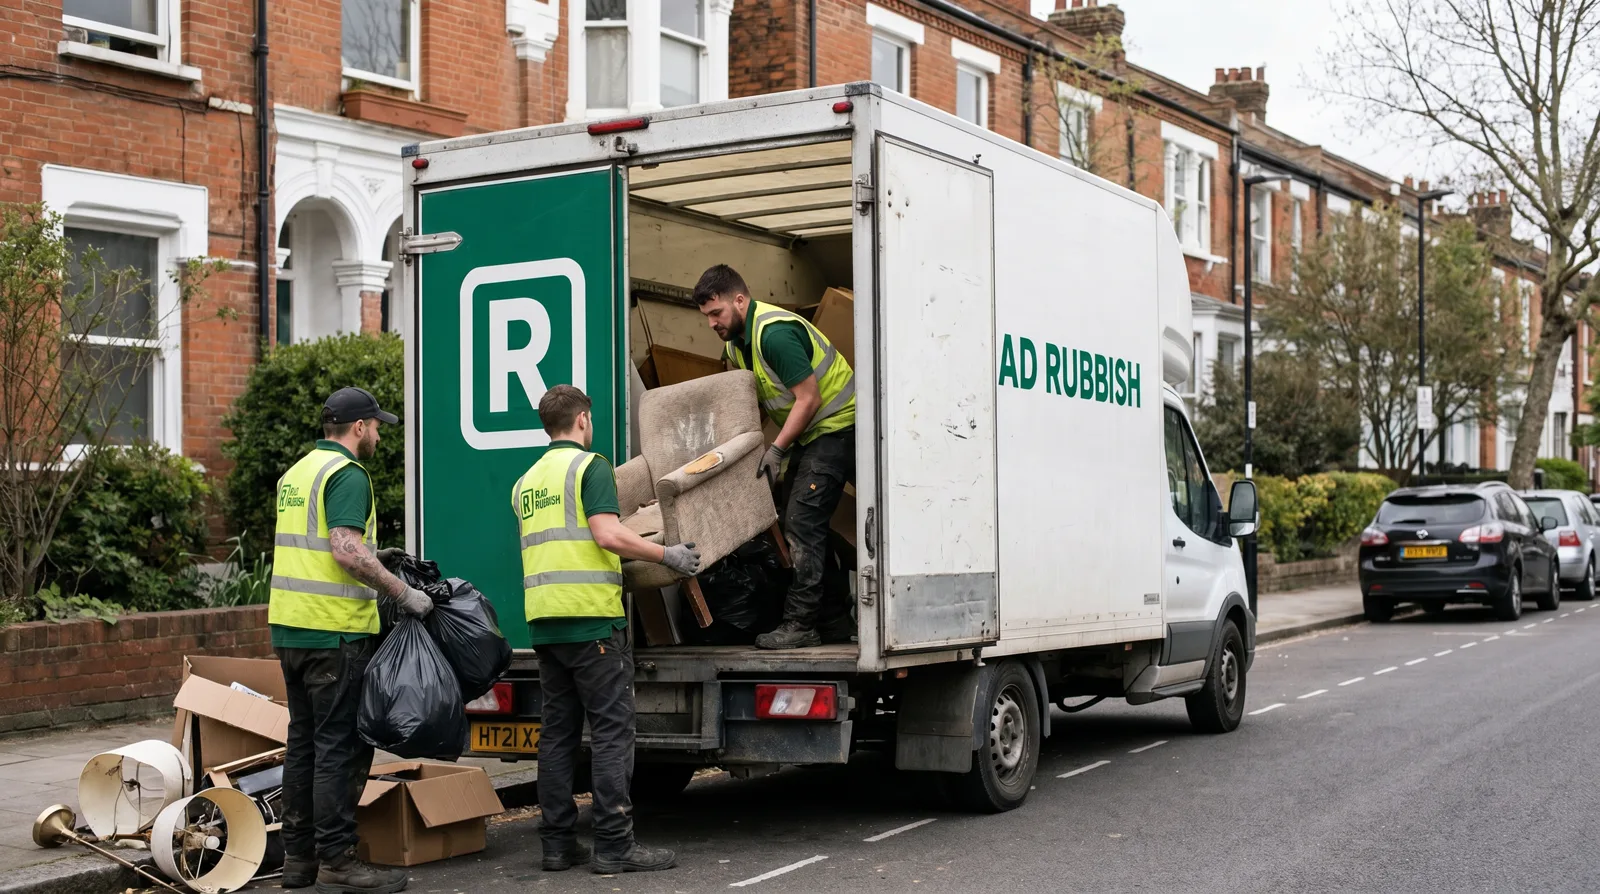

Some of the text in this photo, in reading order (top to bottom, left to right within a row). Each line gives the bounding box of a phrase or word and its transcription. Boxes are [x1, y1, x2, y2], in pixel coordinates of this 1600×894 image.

[489, 297, 551, 413] R
[998, 333, 1141, 408] AD RUBBISH
[479, 726, 517, 748] HT21
